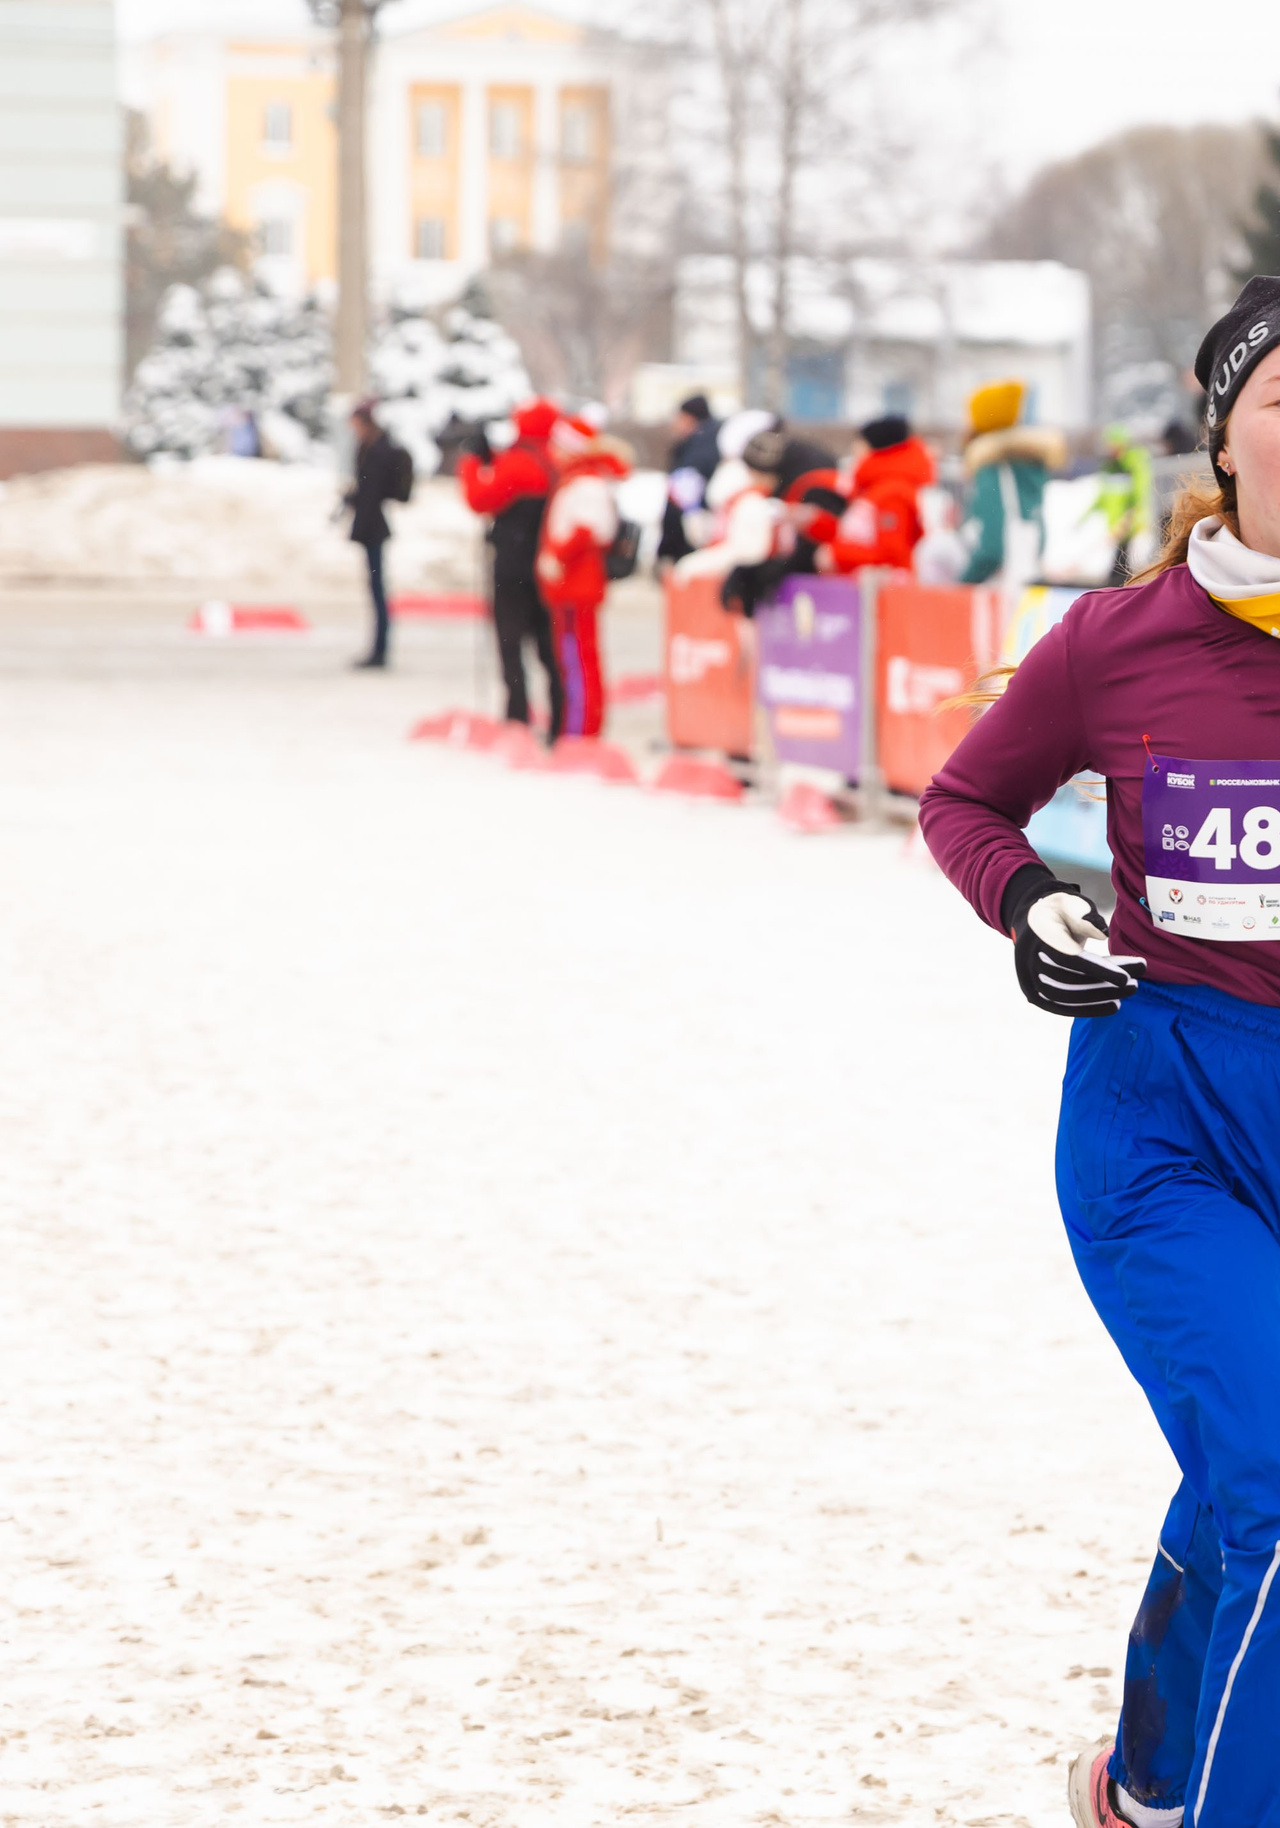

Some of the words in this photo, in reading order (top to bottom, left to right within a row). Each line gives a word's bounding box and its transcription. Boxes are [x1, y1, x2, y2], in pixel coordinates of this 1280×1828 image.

[1215, 319, 1270, 396] UDS
[1167, 777, 1196, 787] КУБОК
[1216, 778, 1280, 786] РОССЕЛЬХОЗБАНК
